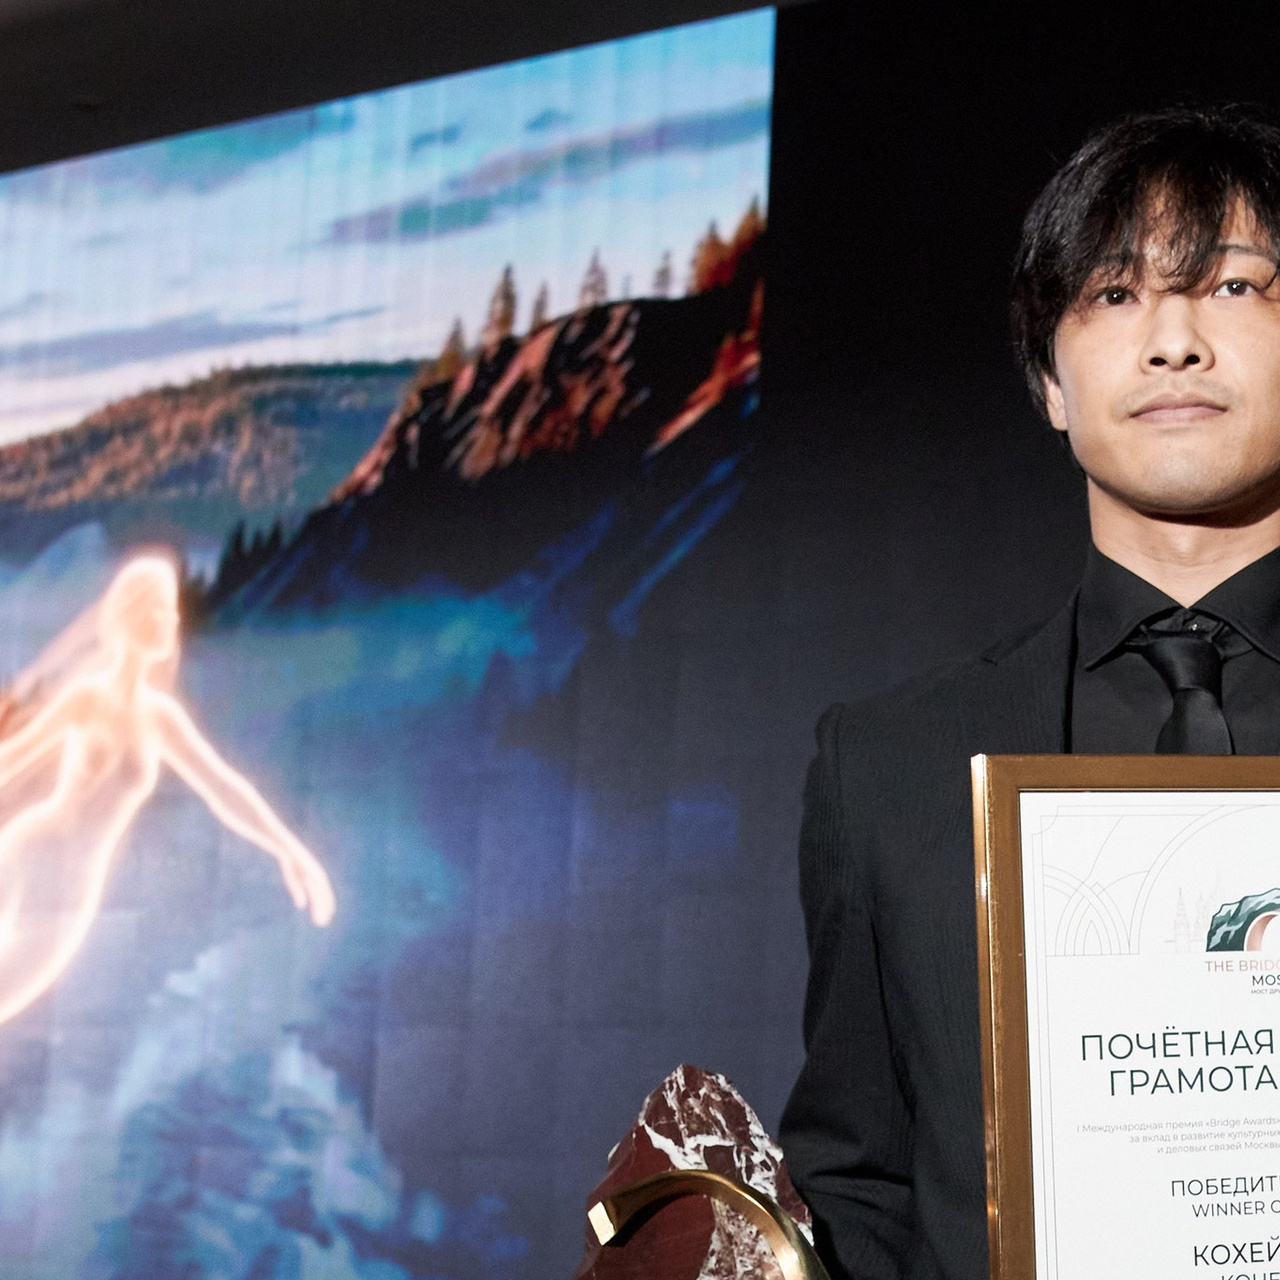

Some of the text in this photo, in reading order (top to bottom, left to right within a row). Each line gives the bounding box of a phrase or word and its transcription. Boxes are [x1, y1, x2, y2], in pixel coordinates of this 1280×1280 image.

[1205, 959, 1233, 972] THE
[1081, 1025, 1274, 1061] ПОЧЁТНАЯ
[1110, 1065, 1279, 1097] ГРАМОТА
[1082, 1122, 1163, 1133] Международная
[1165, 1120, 1203, 1130] премия
[1142, 1134, 1170, 1143] вклад
[1180, 1132, 1225, 1142] развитие
[1227, 1130, 1280, 1140] культурных
[1165, 1145, 1206, 1156] деловых
[1208, 1142, 1242, 1152] связей
[1244, 1141, 1280, 1150] Москвы
[1192, 1200, 1265, 1217] WINNER
